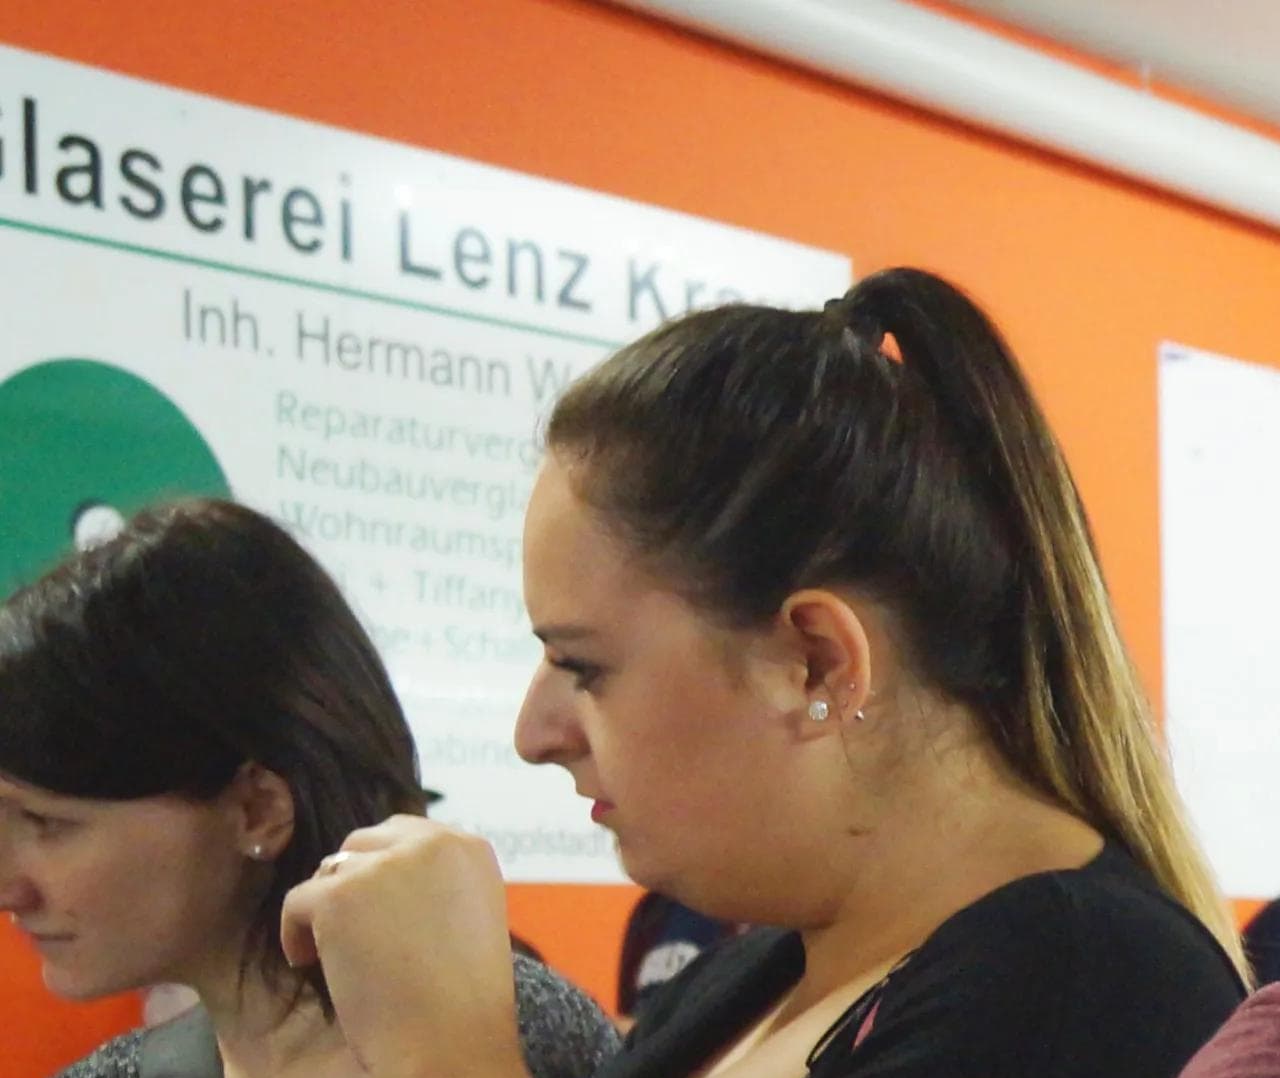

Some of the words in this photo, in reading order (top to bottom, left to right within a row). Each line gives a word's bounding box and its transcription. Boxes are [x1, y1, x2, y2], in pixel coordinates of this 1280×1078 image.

[0, 96, 353, 262] laserei
[399, 205, 592, 312] Lenz
[182, 287, 275, 359] Inh.
[296, 310, 511, 400] Hermann
